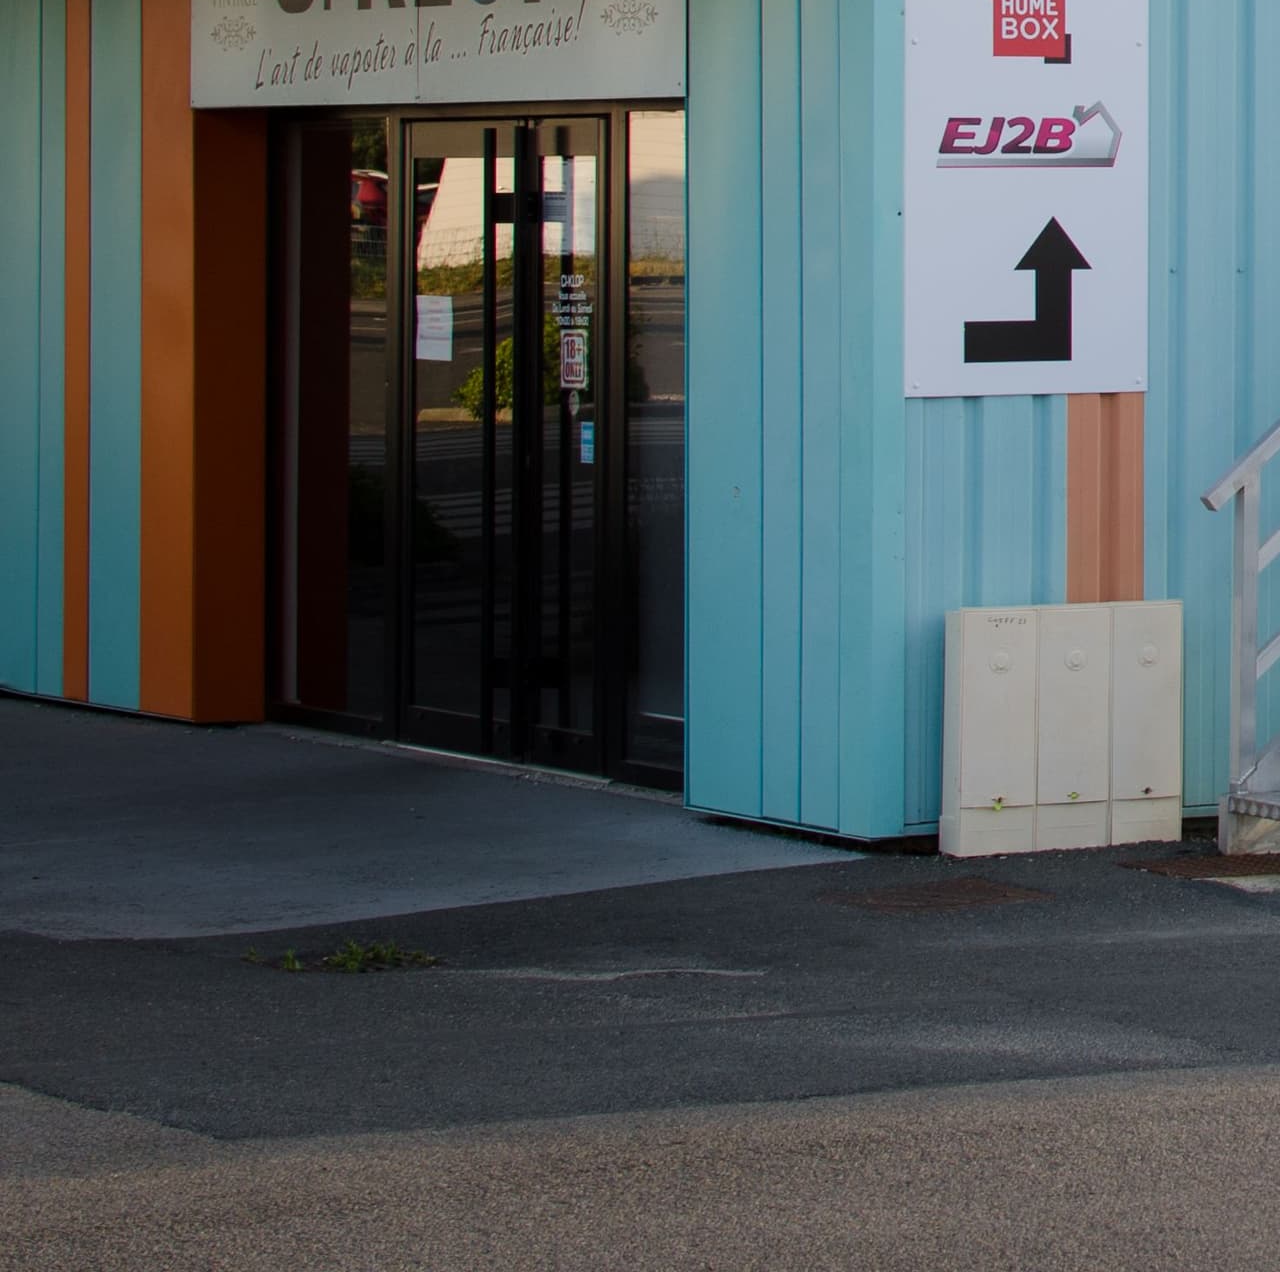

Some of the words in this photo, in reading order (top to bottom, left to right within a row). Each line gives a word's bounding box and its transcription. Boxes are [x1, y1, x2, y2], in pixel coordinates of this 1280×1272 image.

[1001, 17, 1059, 40] BOX
[254, 46, 301, 90] L'art
[304, 39, 322, 80] de
[331, 33, 396, 91] vapoter
[404, 28, 417, 66] à
[424, 21, 441, 65] la
[938, 116, 1076, 155] EJ2B
[565, 339, 582, 359] 18+
